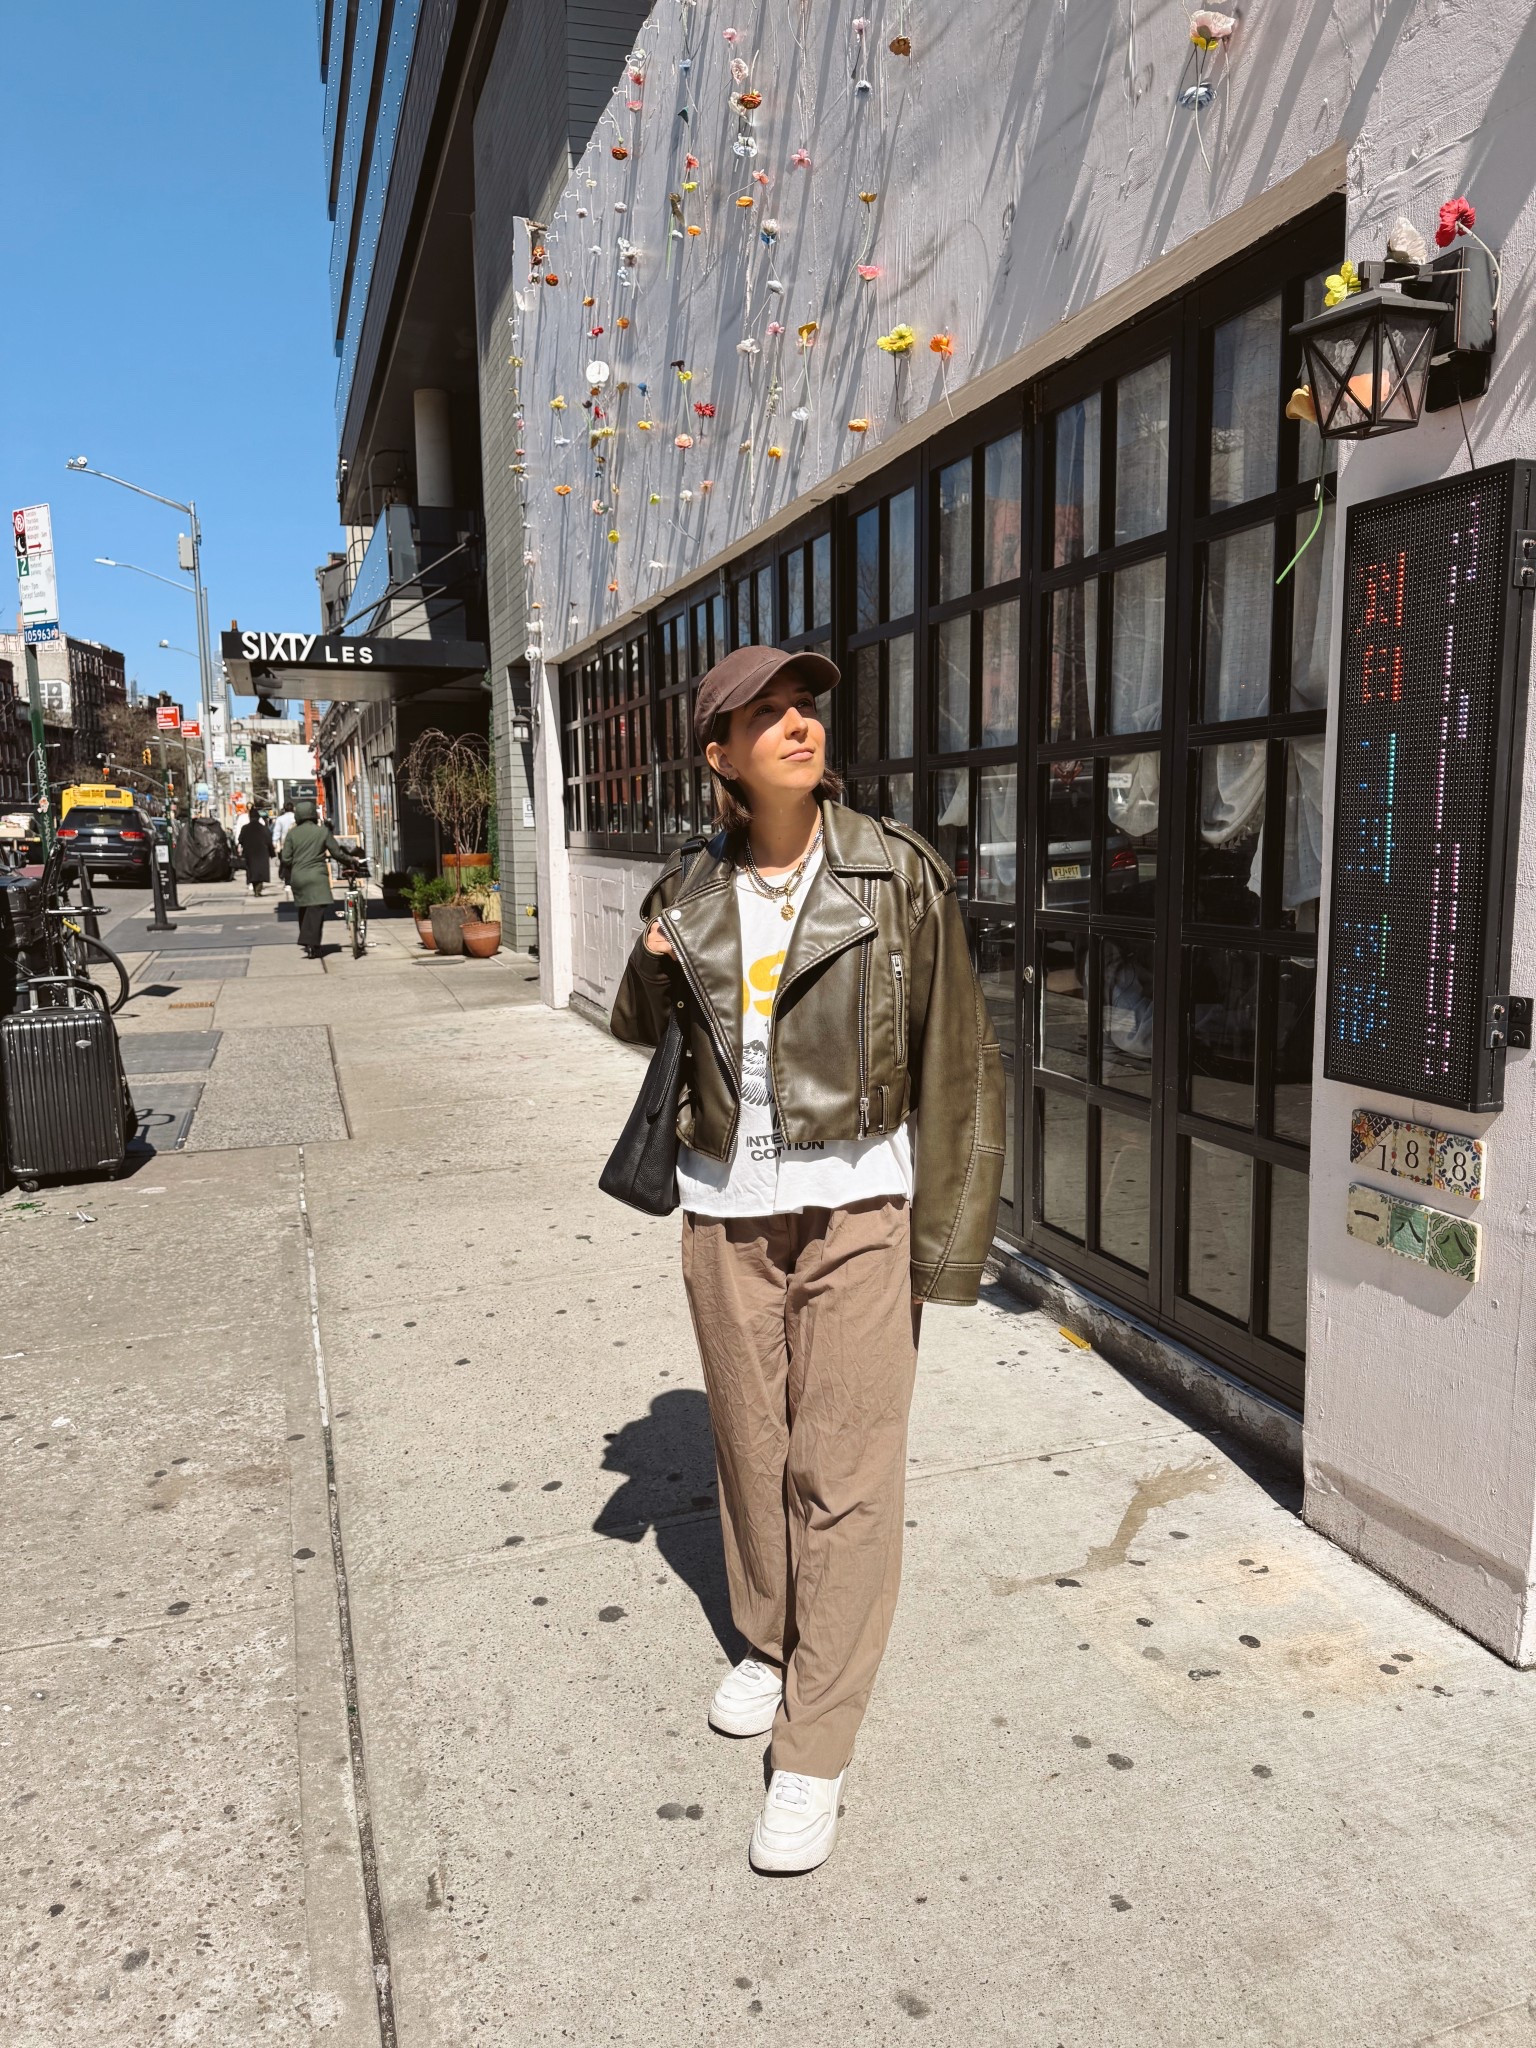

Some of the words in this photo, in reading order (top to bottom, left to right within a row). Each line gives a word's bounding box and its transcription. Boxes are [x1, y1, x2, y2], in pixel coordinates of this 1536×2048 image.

[20, 559, 27, 576] 2
[25, 627, 51, 643] 105963
[242, 631, 317, 662] SIXTY
[325, 645, 374, 664] LES
[746, 1132, 783, 1148] INTE
[1377, 1140, 1467, 1182] 188
